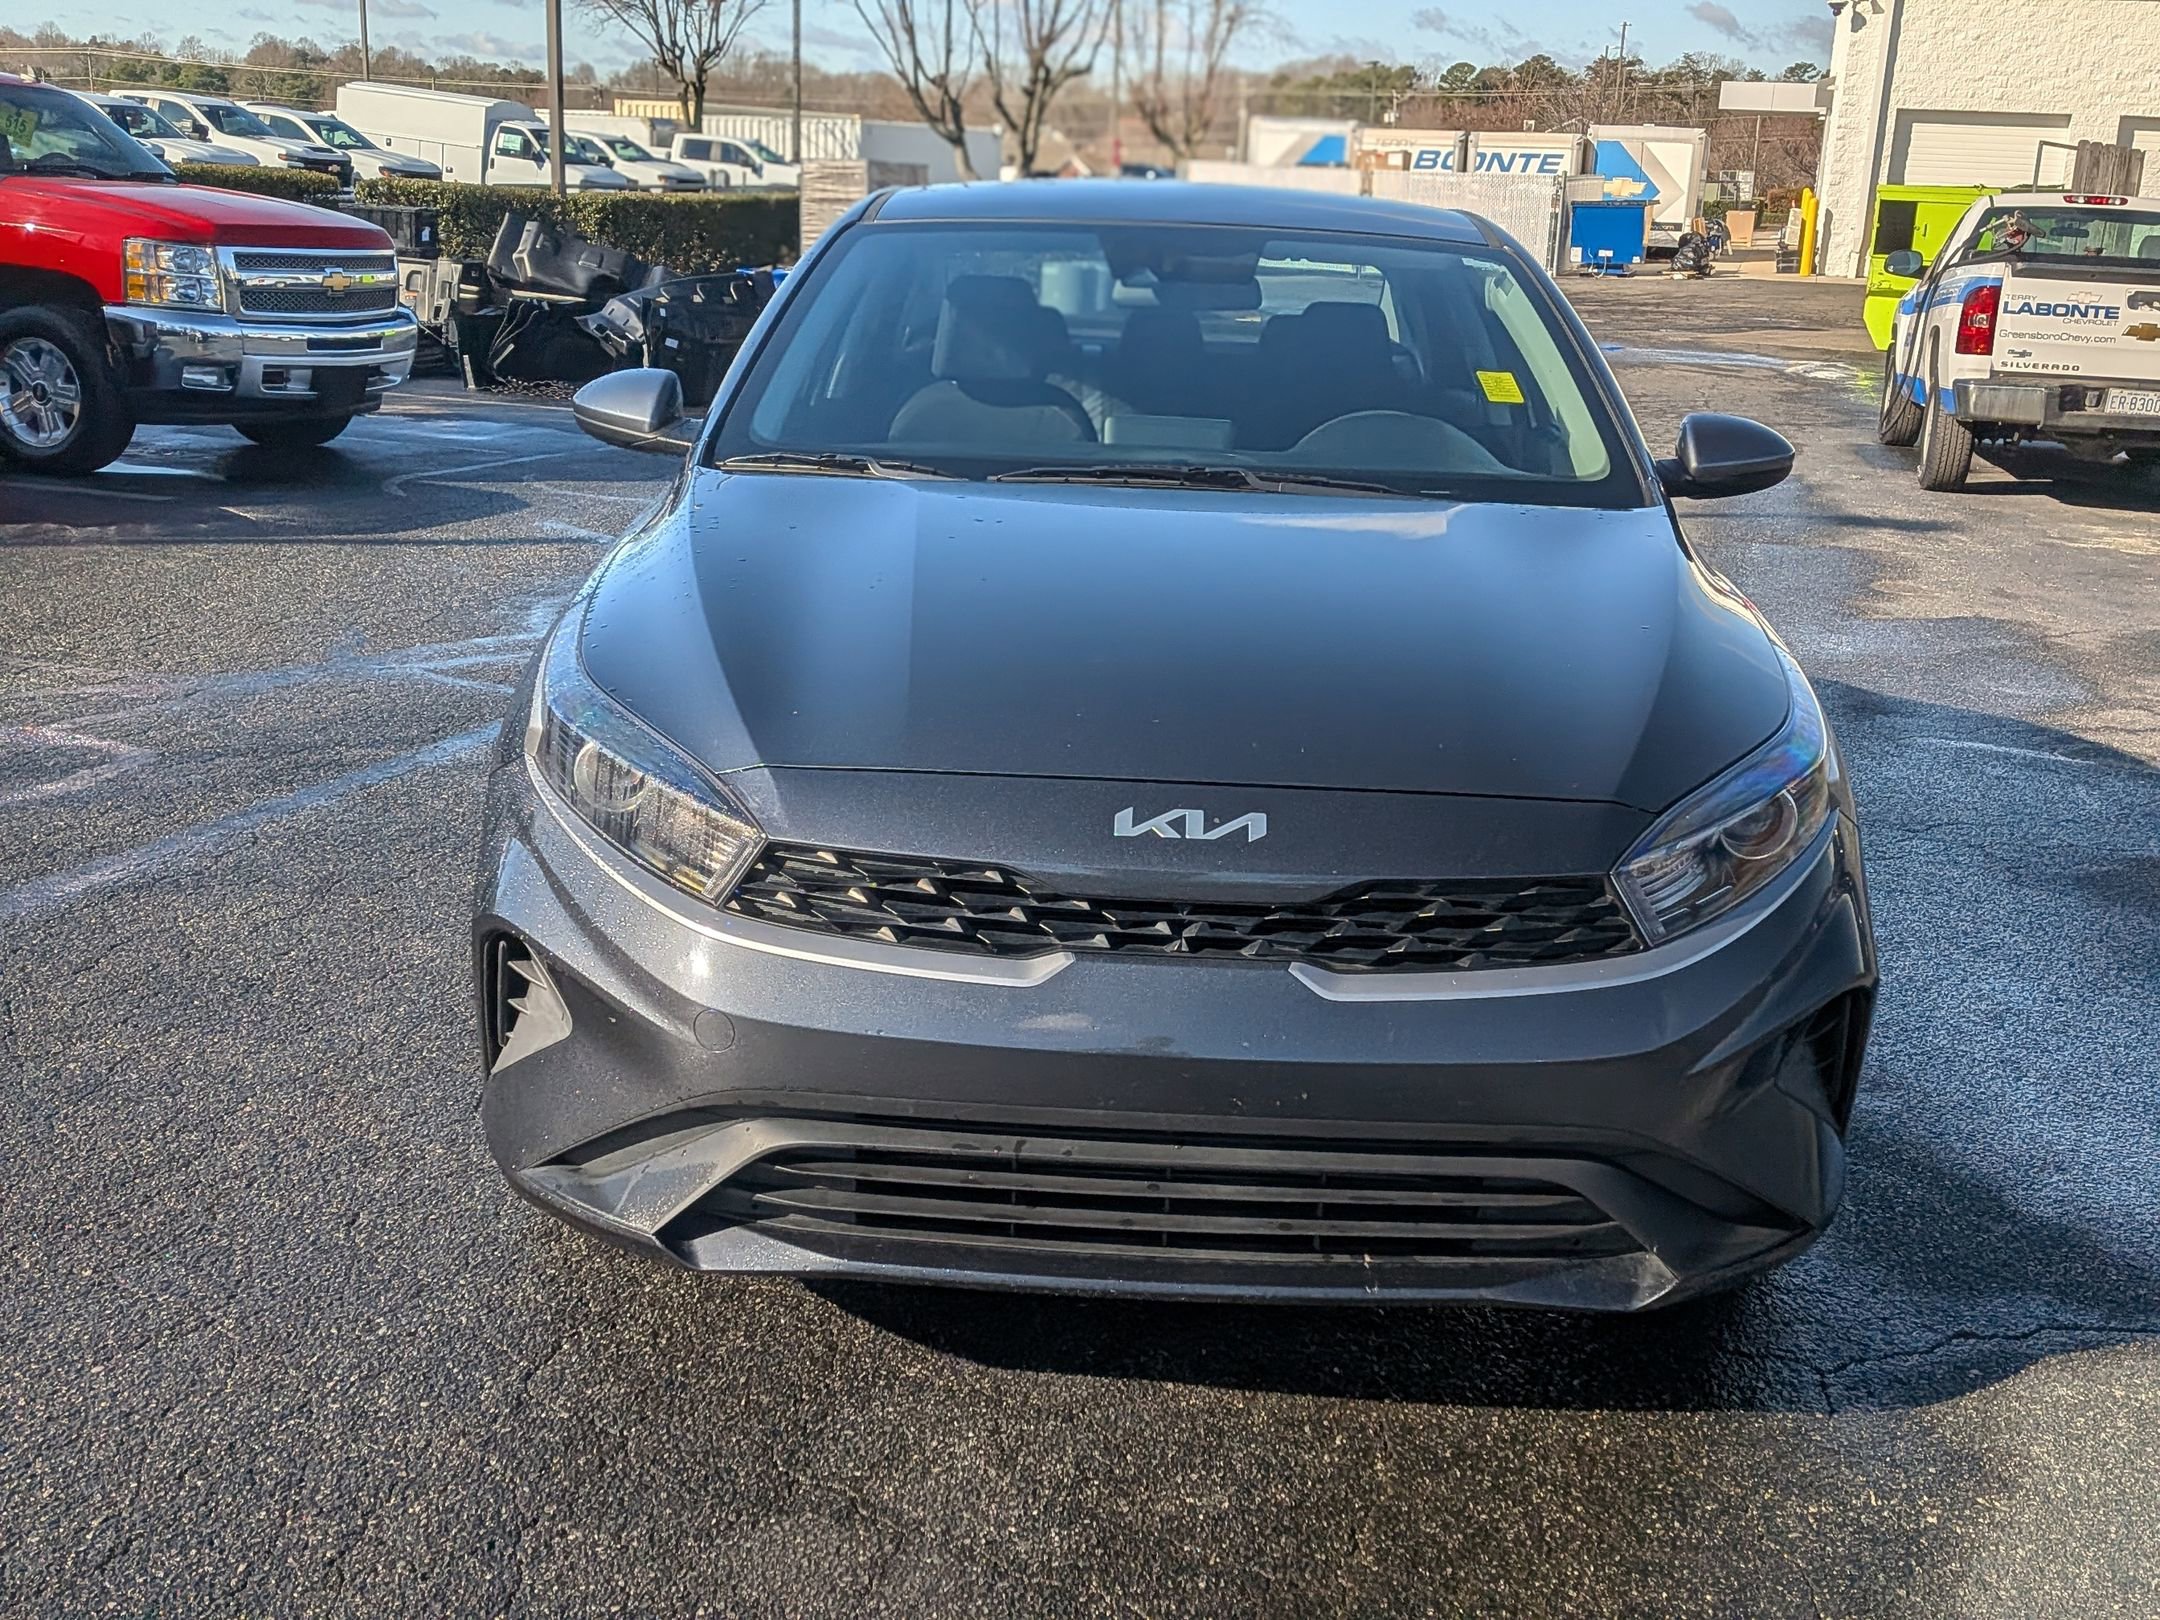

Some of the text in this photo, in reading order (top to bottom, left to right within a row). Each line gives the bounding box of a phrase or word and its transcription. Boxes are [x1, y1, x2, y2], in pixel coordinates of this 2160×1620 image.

[2005, 293, 2038, 301] TERRY
[2002, 301, 2121, 320] LABONTE
[2062, 317, 2120, 327] CHEVROLET
[1999, 328, 2117, 344] GreensboroChevy.com
[2000, 361, 2081, 372] SILVERADO
[1113, 806, 1268, 843] KIA
